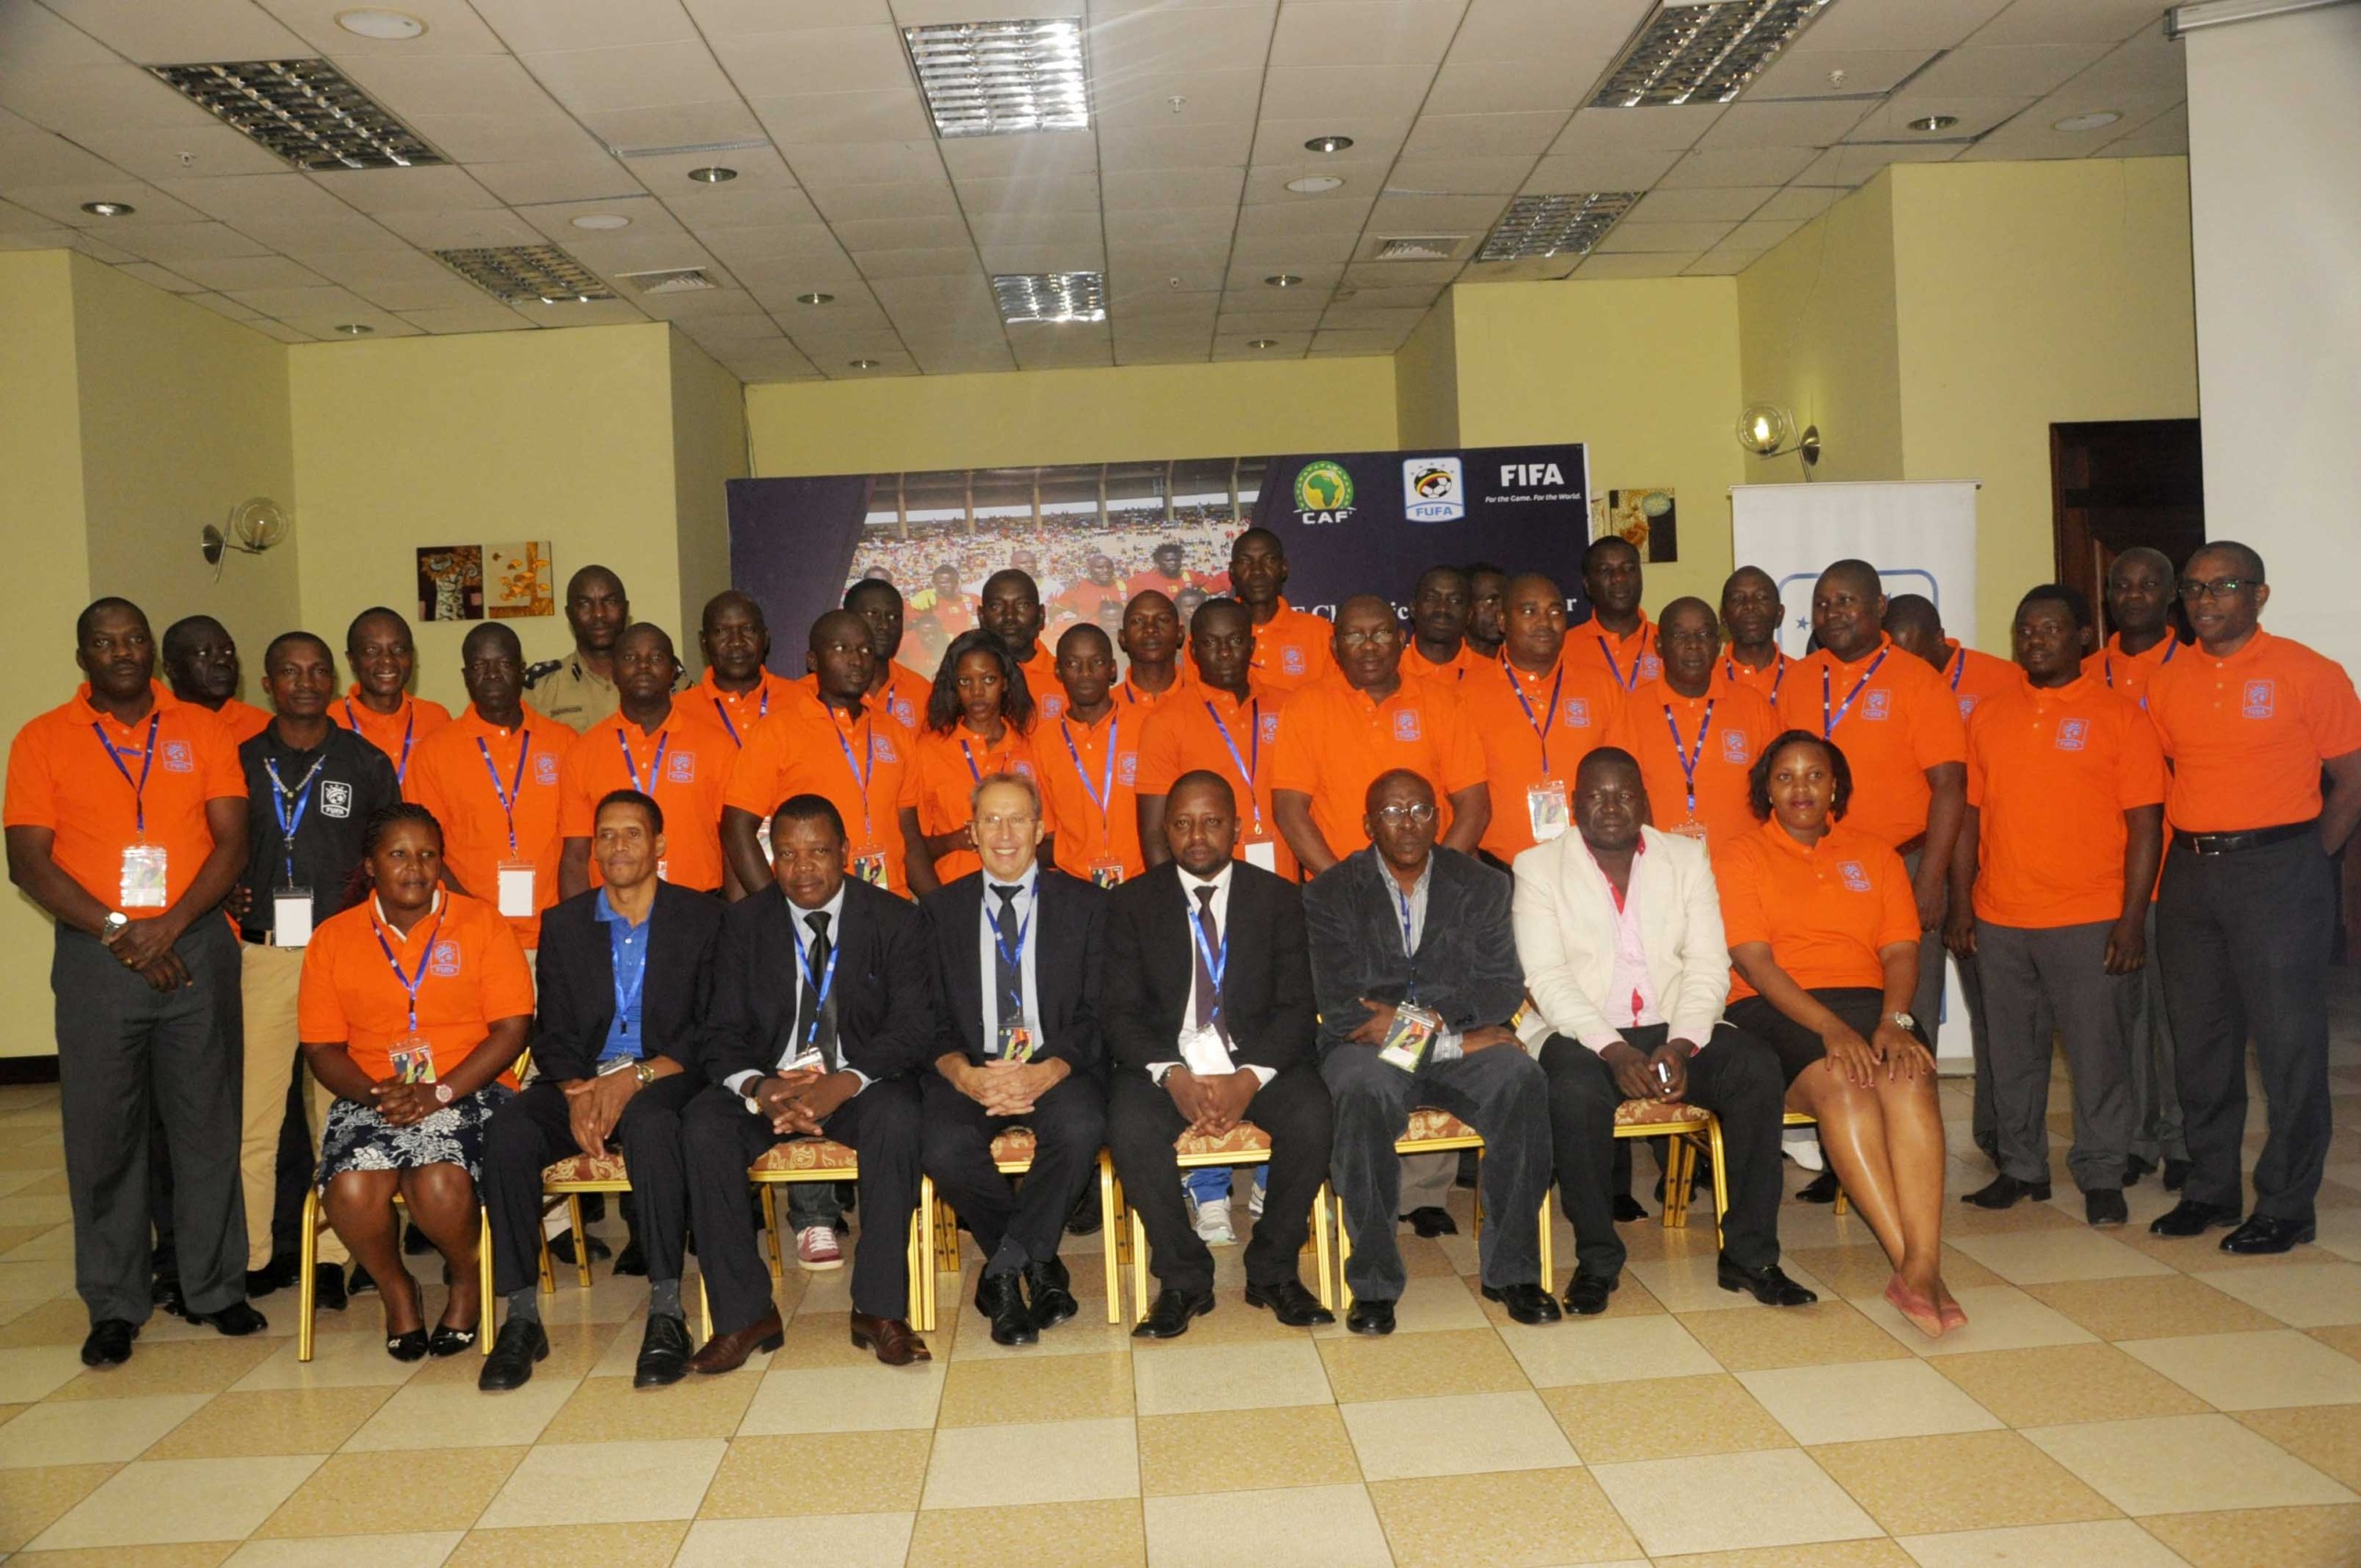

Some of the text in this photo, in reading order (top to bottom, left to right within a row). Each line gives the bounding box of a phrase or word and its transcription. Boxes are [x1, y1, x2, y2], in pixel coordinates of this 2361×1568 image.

[1501, 463, 1565, 487] FIFA
[1302, 511, 1347, 524] CAF
[1416, 506, 1453, 517] FUFA
[326, 807, 345, 815] FUFA
